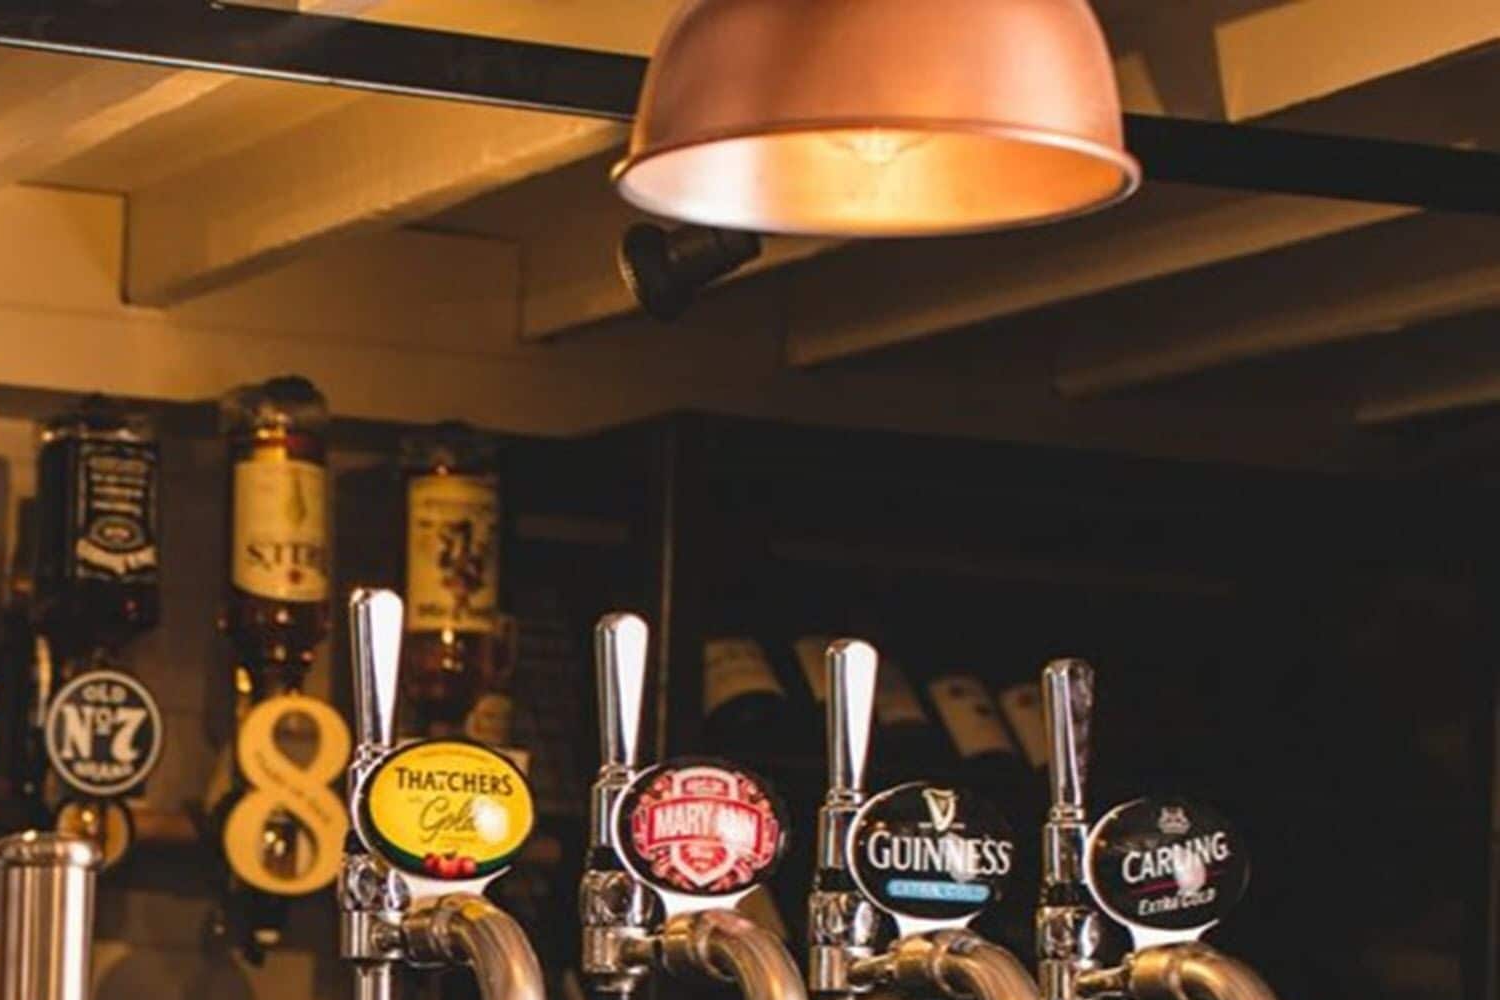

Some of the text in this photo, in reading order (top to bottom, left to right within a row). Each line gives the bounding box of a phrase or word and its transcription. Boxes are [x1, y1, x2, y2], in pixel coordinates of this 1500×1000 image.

[82, 684, 128, 704] OLD
[394, 765, 514, 797] THATCHERS
[653, 804, 712, 841] MARY
[866, 829, 1013, 877] GUINNESS
[1121, 831, 1231, 884] CARLING
